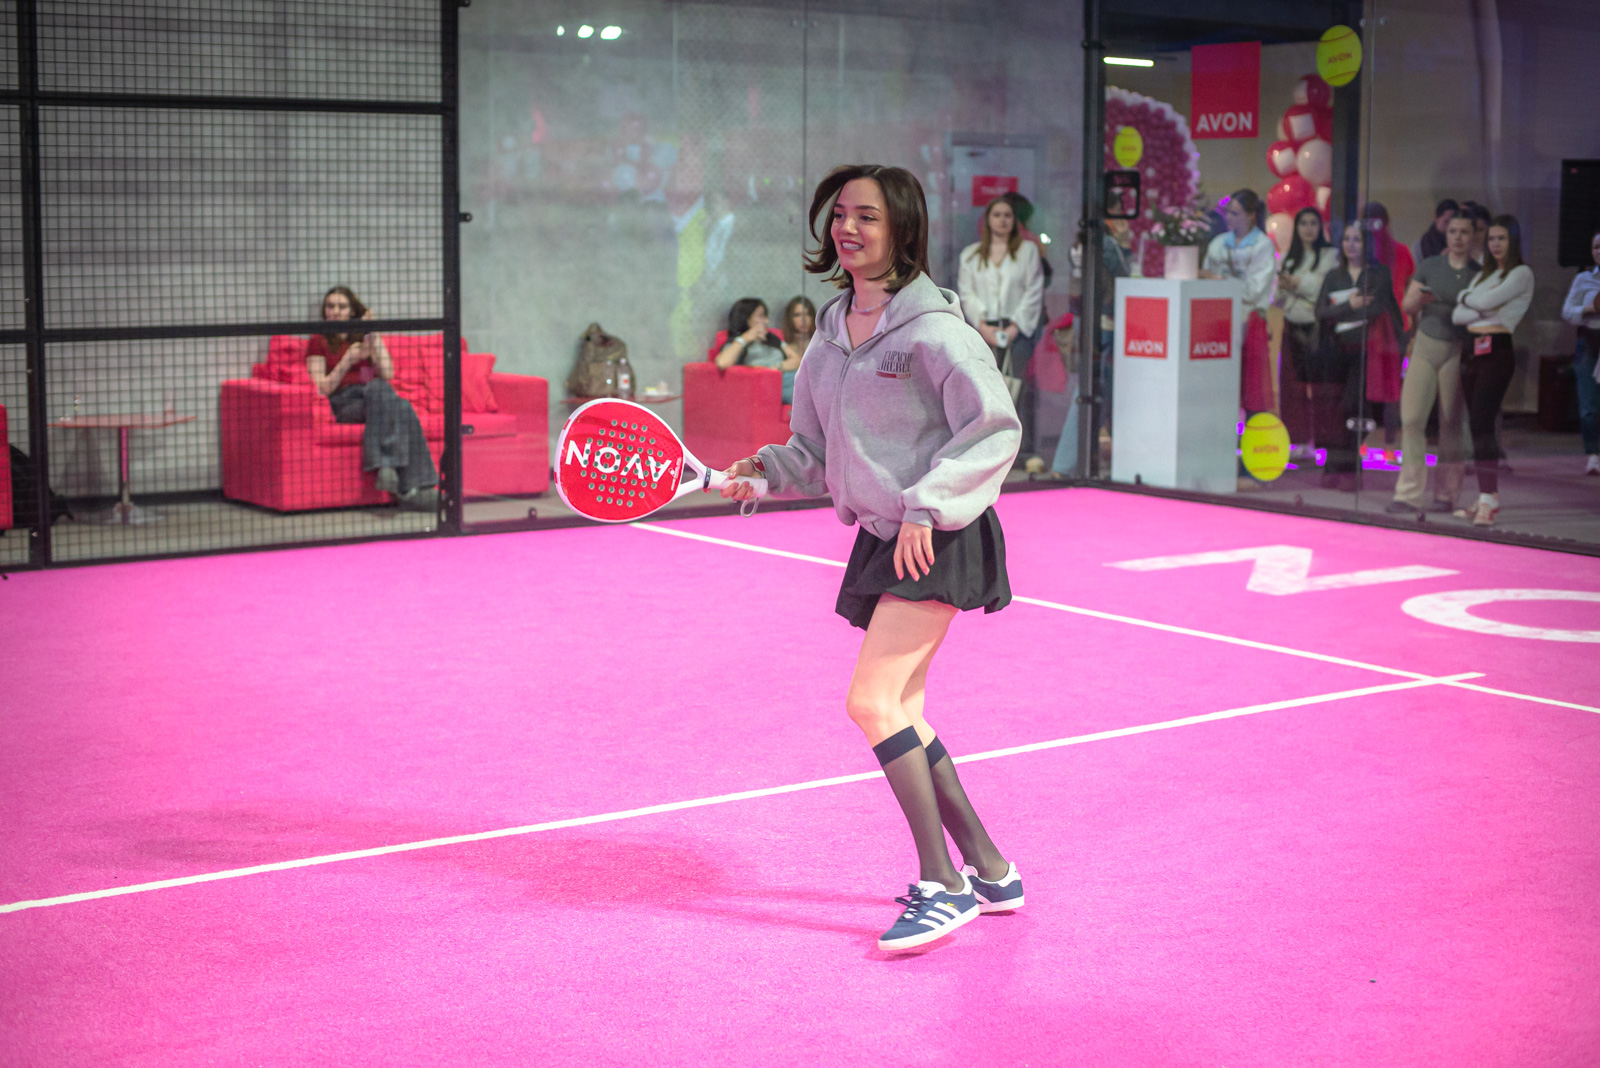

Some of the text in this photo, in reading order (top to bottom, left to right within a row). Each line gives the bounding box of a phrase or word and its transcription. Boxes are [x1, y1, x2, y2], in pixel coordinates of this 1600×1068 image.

[1328, 52, 1353, 64] AVON
[1196, 112, 1253, 133] AVON
[1127, 340, 1164, 355] AVON
[1192, 341, 1228, 355] AVON
[564, 439, 672, 483] AVON
